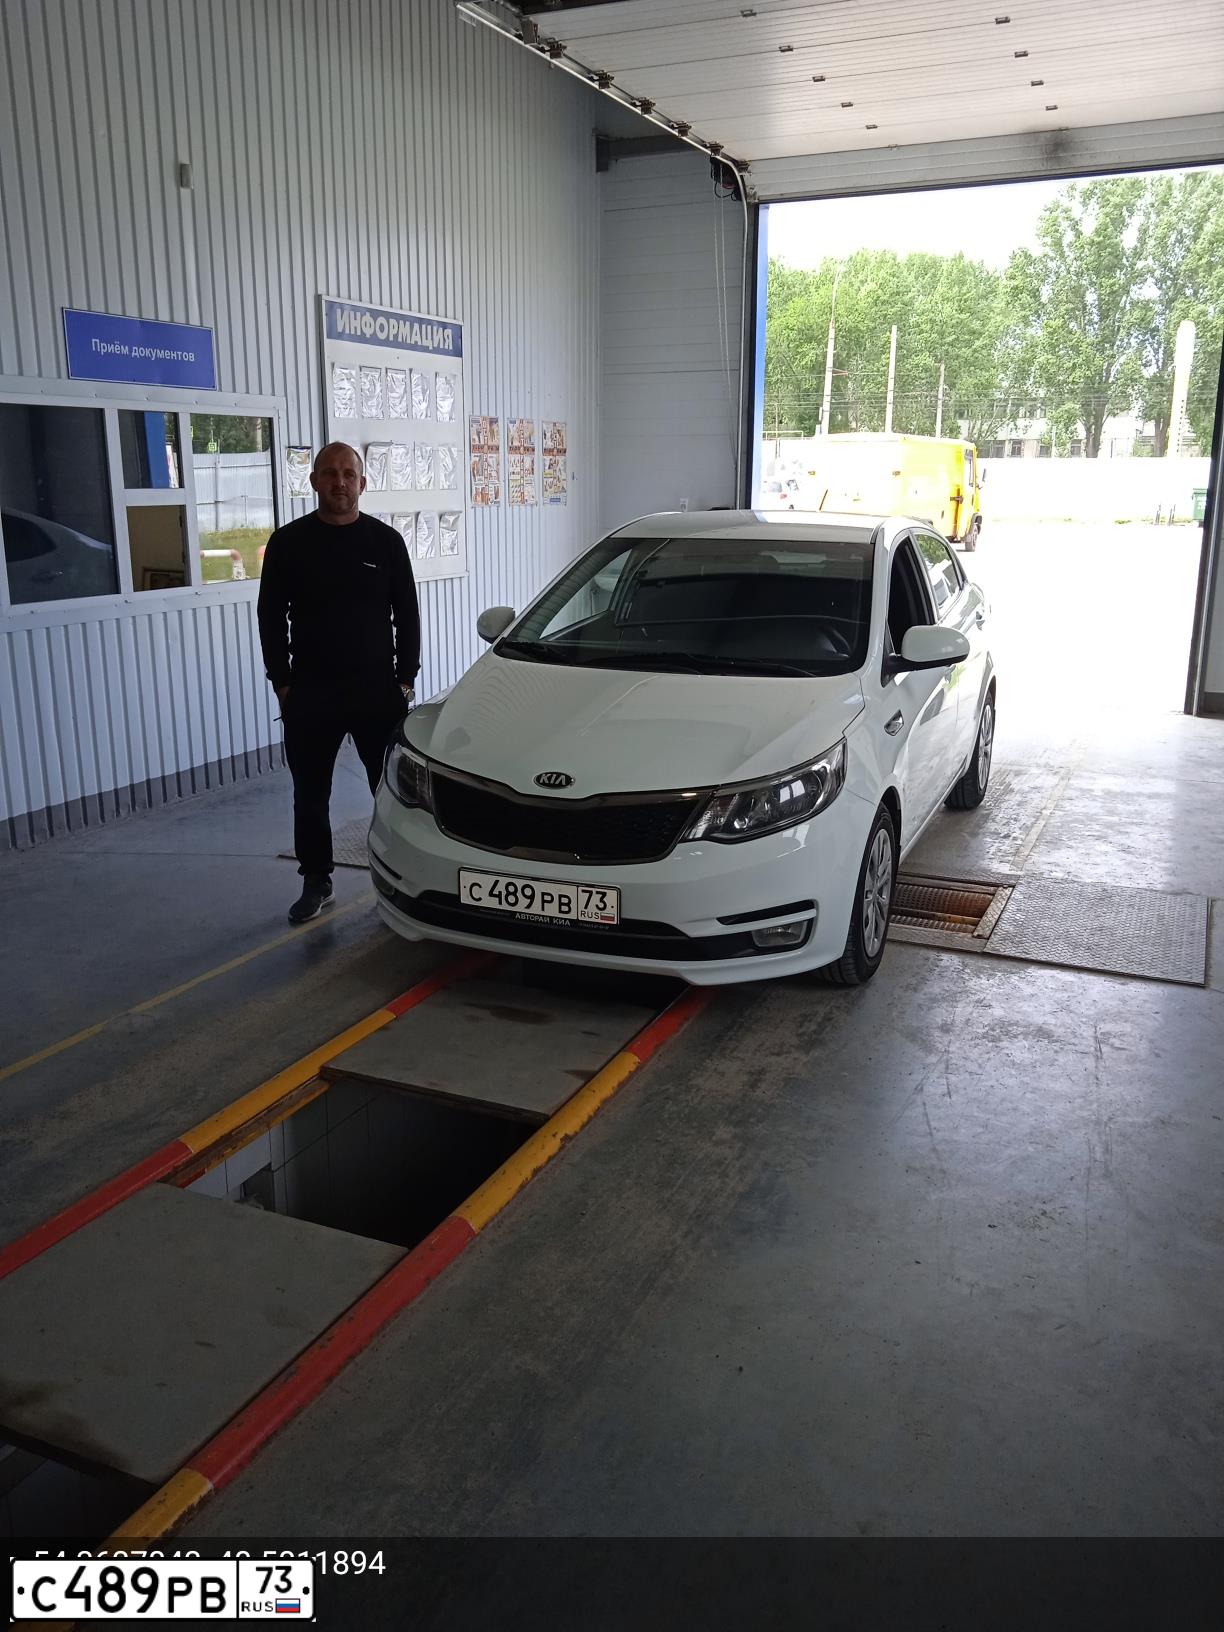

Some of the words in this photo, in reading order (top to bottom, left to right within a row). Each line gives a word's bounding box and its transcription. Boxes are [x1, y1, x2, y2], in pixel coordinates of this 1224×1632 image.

[336, 308, 453, 350] ИНФОРМАЦИЯ
[91, 338, 129, 355] Приём
[131, 346, 195, 362] документов
[539, 773, 566, 786] KIA
[581, 889, 608, 912] 73
[553, 917, 571, 927] КИА
[580, 910, 600, 920] RUS
